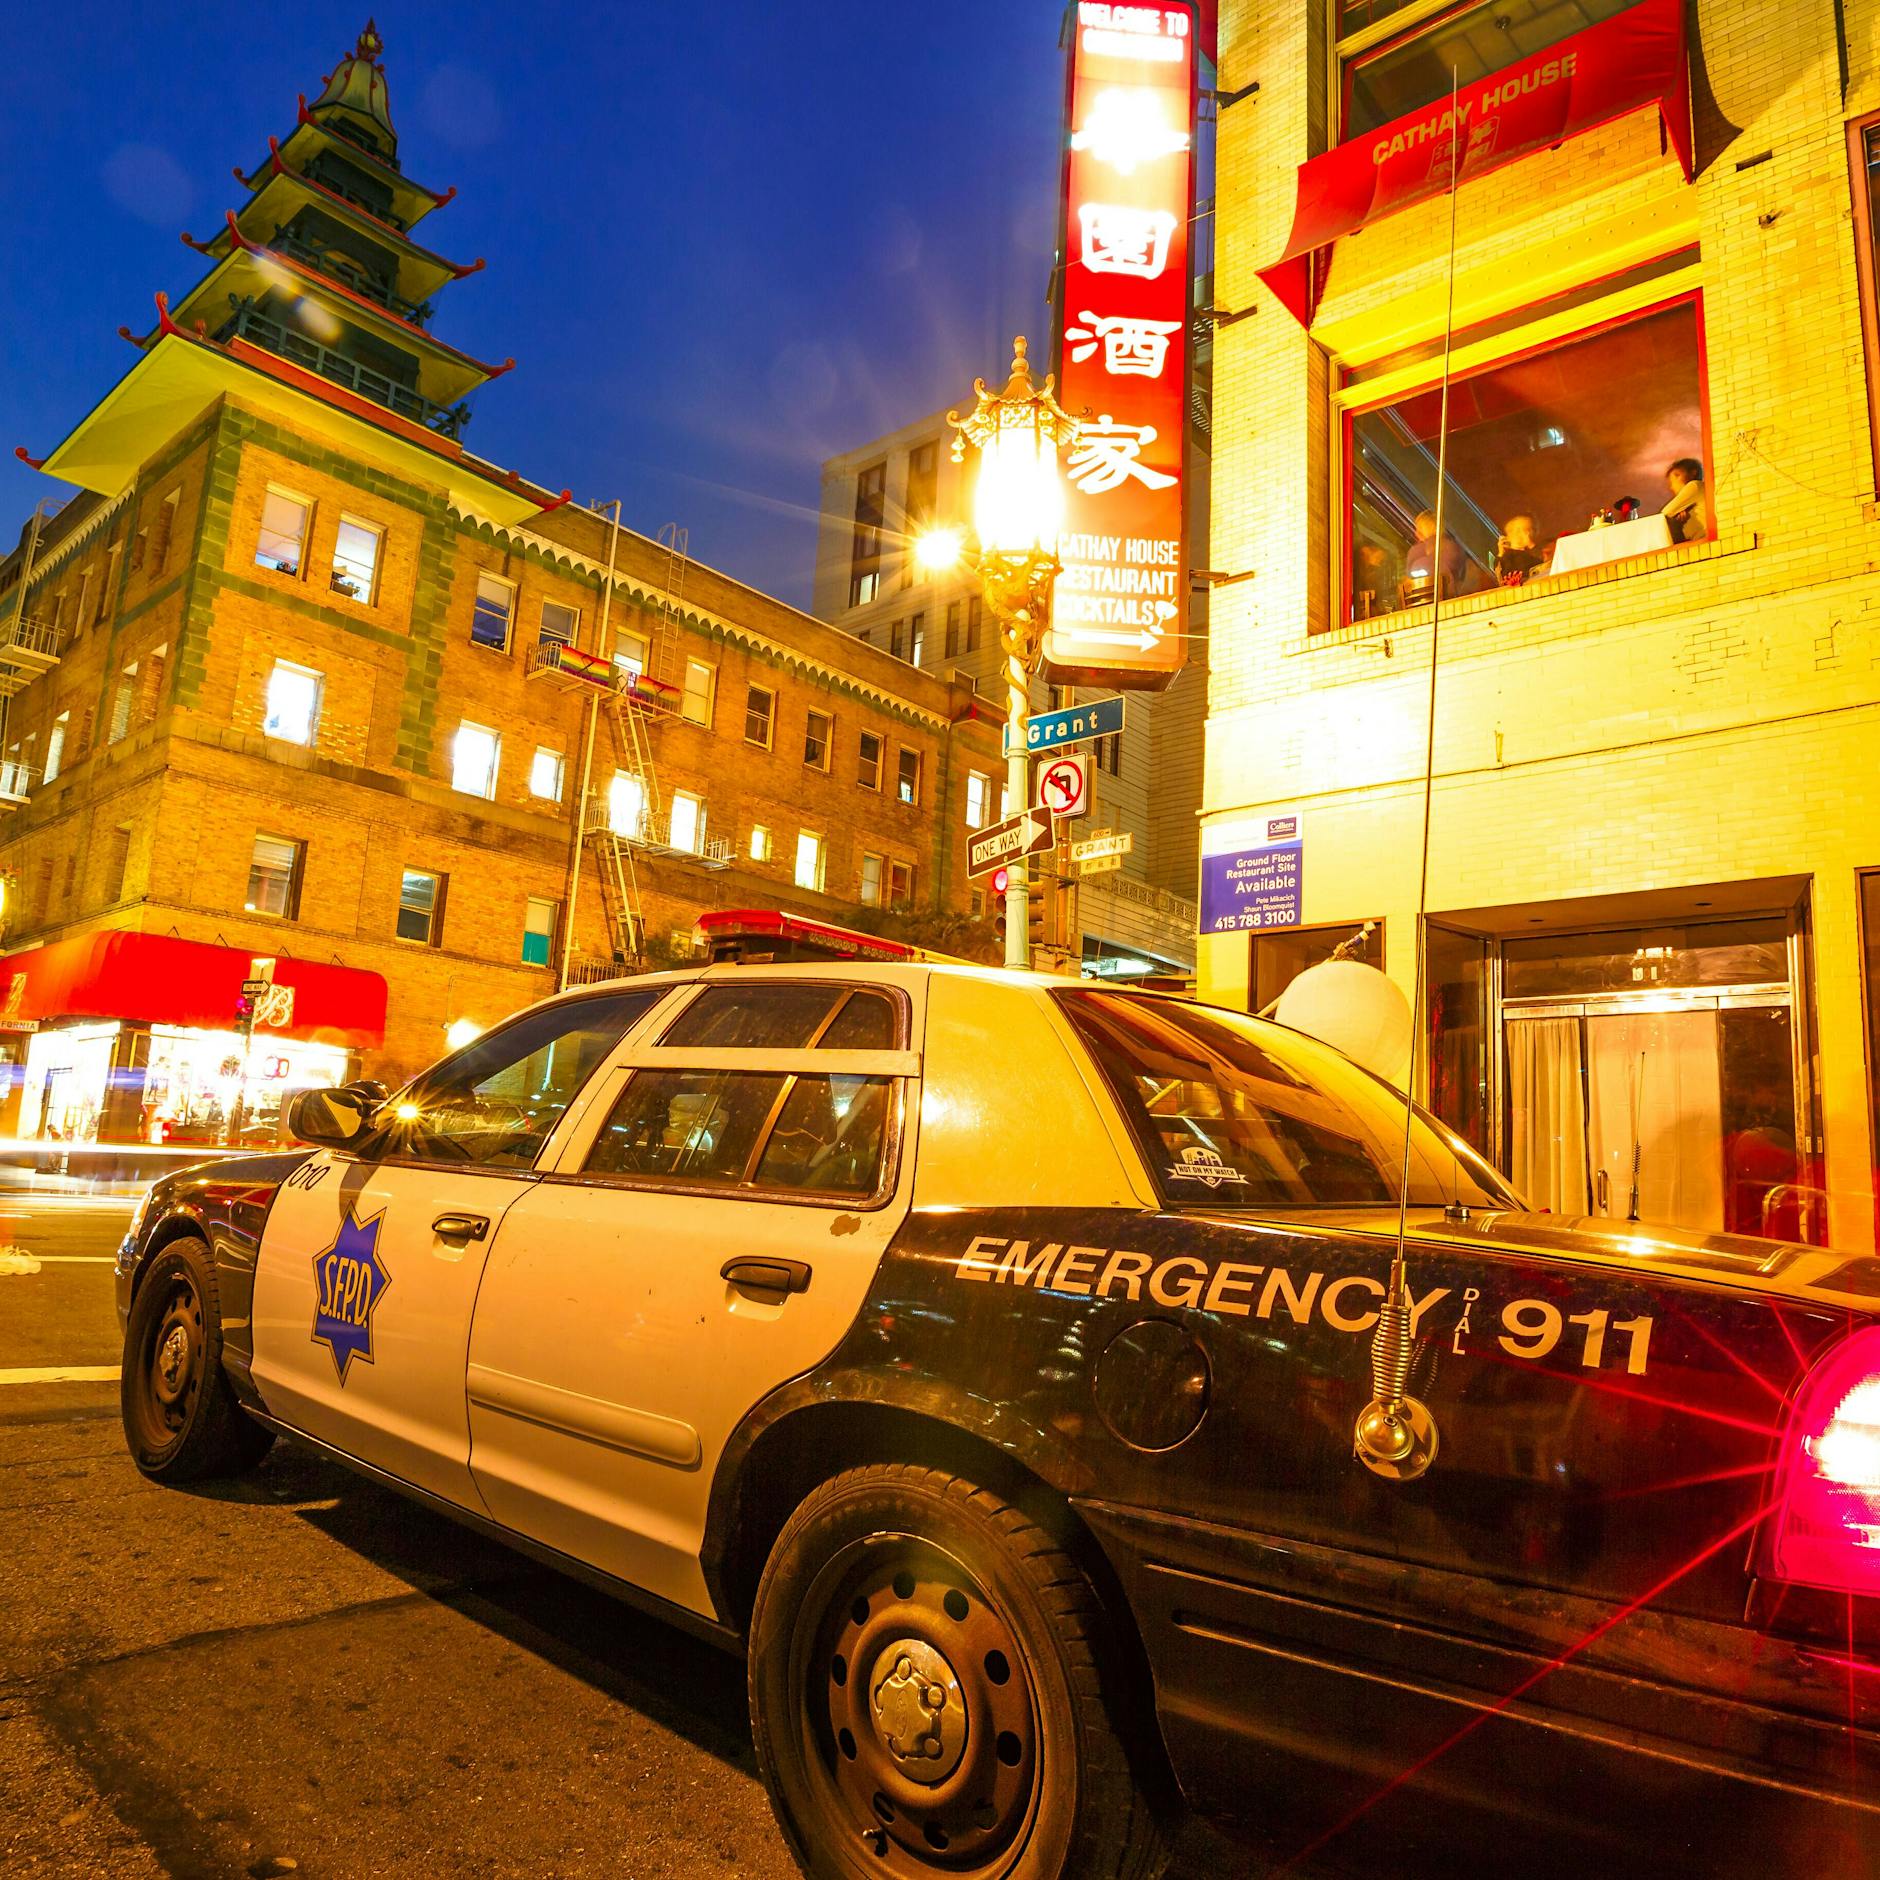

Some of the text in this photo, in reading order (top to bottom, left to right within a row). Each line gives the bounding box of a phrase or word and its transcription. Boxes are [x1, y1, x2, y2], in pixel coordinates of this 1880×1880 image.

[1165, 11, 1189, 36] TO
[1372, 101, 1473, 164] CATHAY
[1481, 52, 1578, 114] HOUSE
[1058, 533, 1179, 565] CATHAY HOUSE
[1027, 711, 1098, 744] Grant
[975, 829, 1021, 862] ONE WAY
[1076, 838, 1126, 857] GRANT
[1226, 863, 1296, 879] Restaurant Site
[1236, 853, 1296, 868] Ground Floor
[1235, 875, 1296, 894] Available
[1215, 910, 1295, 929] 415 788 3100
[288, 1163, 331, 1191] 010
[1214, 1169, 1235, 1177] WATCH
[319, 1254, 373, 1329] S.F.P.D.
[955, 1235, 1653, 1376] EMERGENCY DIAL 911
